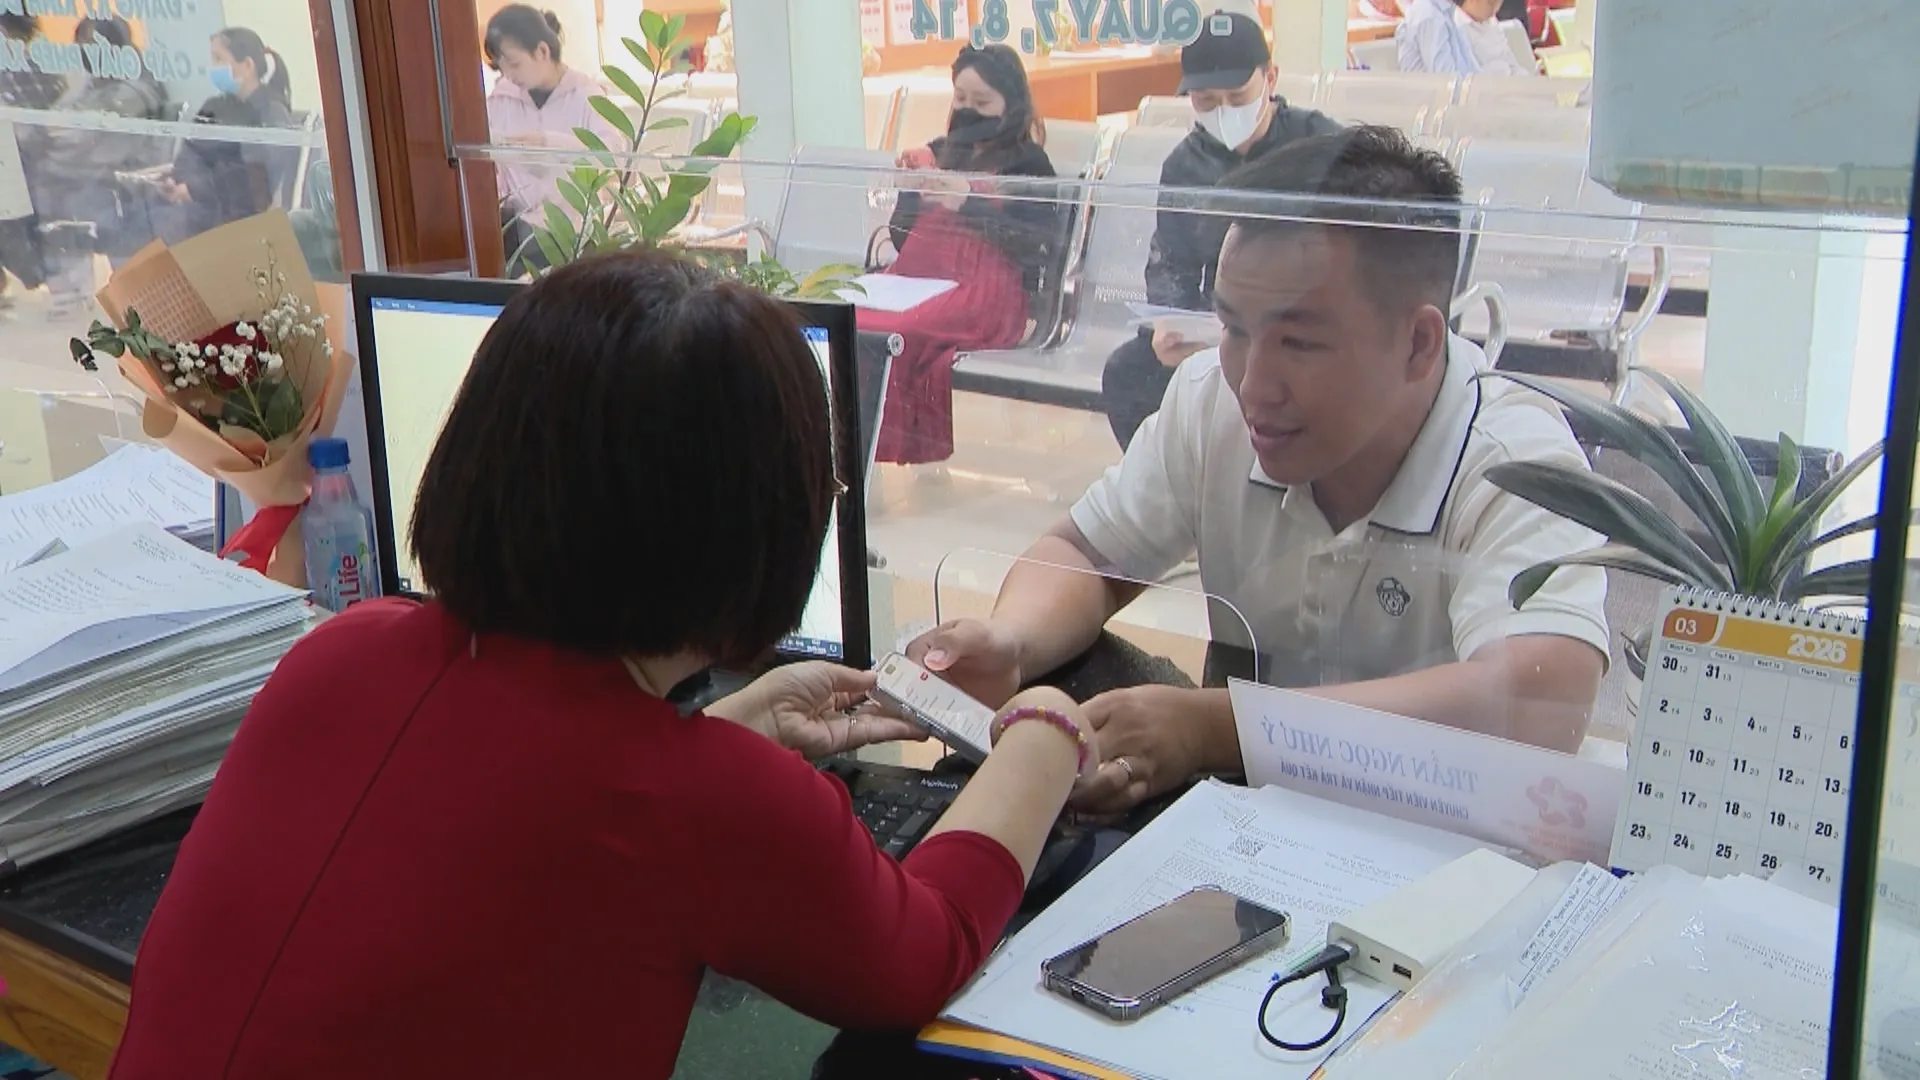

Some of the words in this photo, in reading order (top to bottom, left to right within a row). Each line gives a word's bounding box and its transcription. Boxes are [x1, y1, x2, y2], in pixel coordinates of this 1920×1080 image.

[338, 555, 360, 597] Life
[1674, 617, 1697, 635] 03
[1787, 633, 1848, 663] 2026
[1662, 656, 1678, 672] 30
[1705, 664, 1720, 679] 31
[1659, 699, 1669, 713] 2
[1703, 708, 1712, 721] 3
[1747, 717, 1755, 730] 4
[1792, 725, 1801, 739] 5
[1840, 735, 1848, 749] 6
[1652, 741, 1660, 755] 9
[1689, 749, 1704, 763] 10
[1733, 758, 1747, 773] 11
[1778, 768, 1793, 783] 12
[1825, 777, 1840, 793] 13
[1637, 781, 1651, 796] 16
[1681, 791, 1696, 806] 17
[1725, 801, 1740, 816] 18
[1770, 811, 1785, 827] 19
[1815, 822, 1832, 837] 20
[1630, 824, 1645, 839] 23
[1673, 834, 1689, 849] 24
[1716, 844, 1732, 859] 25
[1761, 854, 1777, 869] 26
